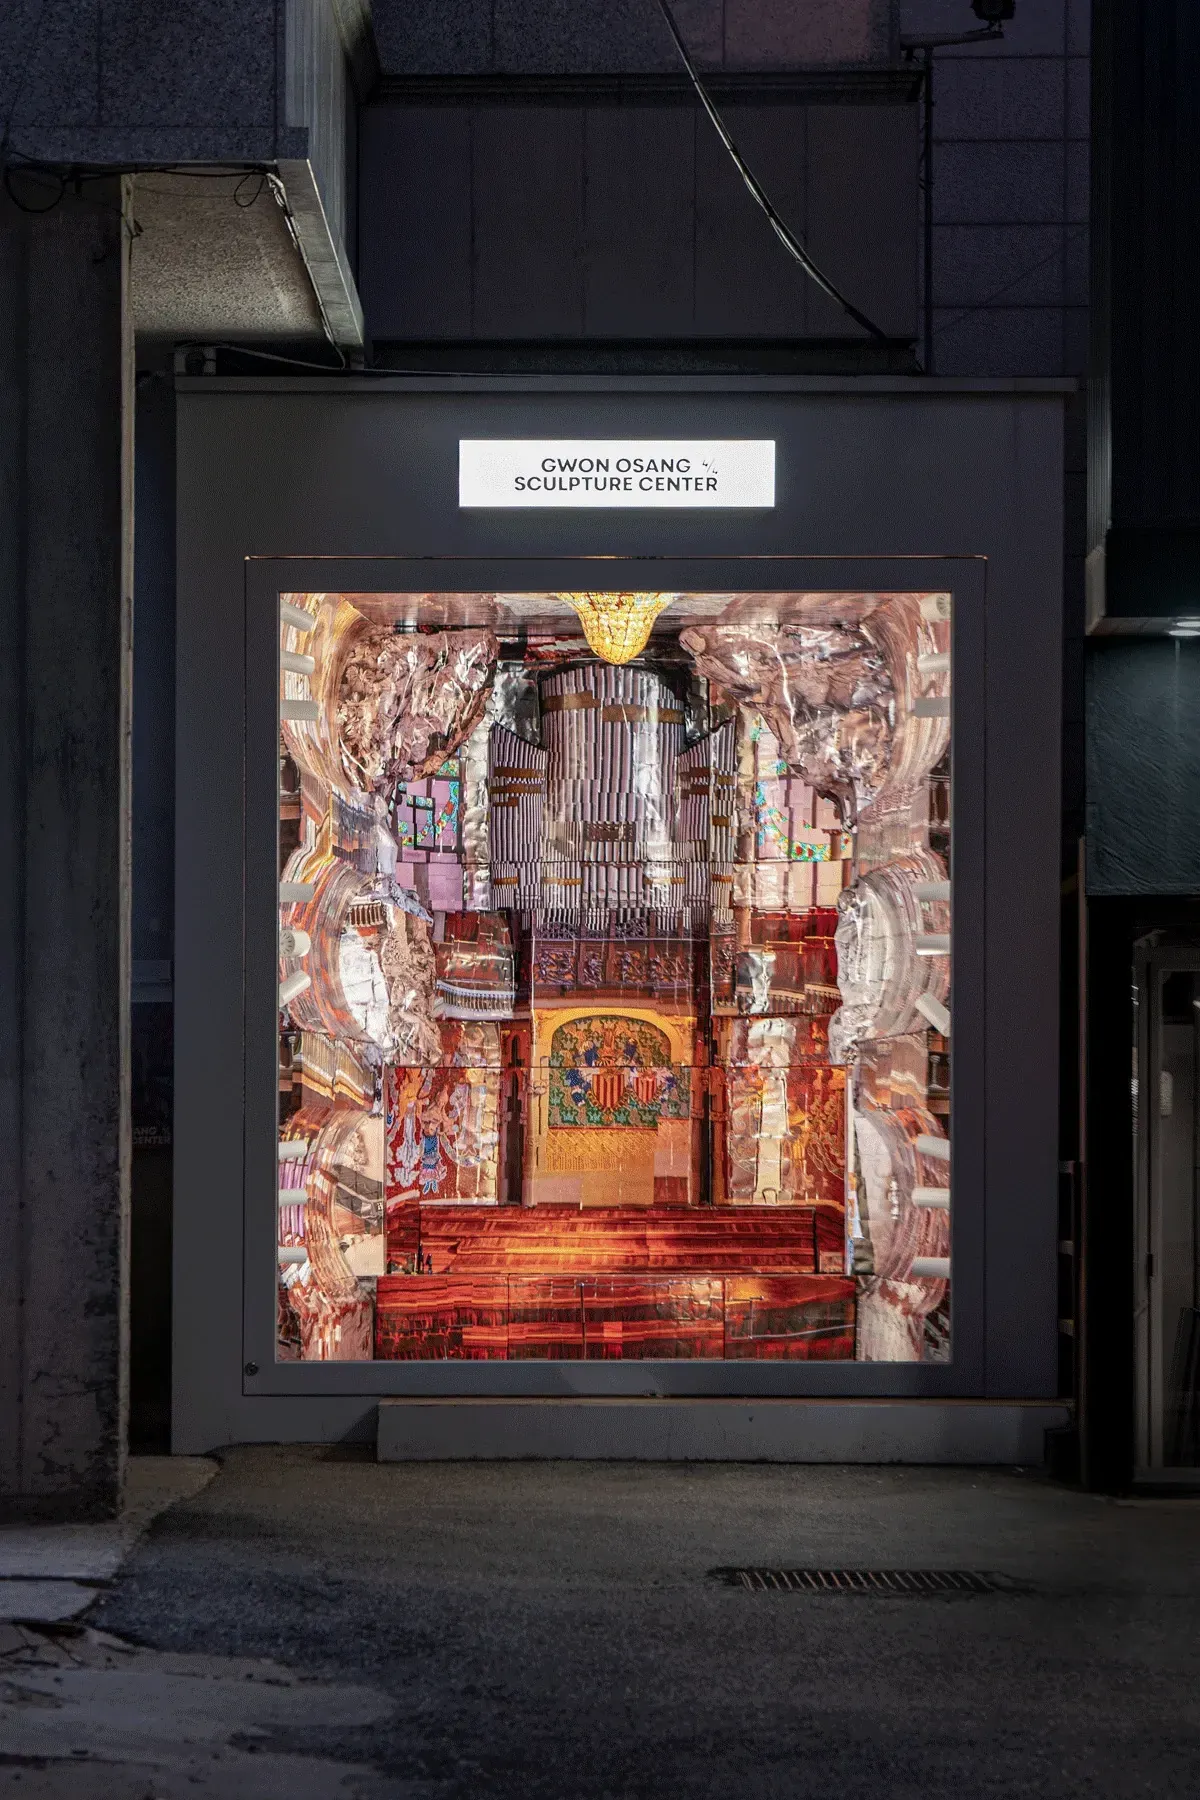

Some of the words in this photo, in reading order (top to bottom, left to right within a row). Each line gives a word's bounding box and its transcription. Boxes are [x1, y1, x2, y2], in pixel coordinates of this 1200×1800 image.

[541, 458, 609, 473] GWON
[615, 458, 691, 473] OSANG
[514, 476, 633, 492] SCULPTURE
[638, 476, 718, 492] CENTER
